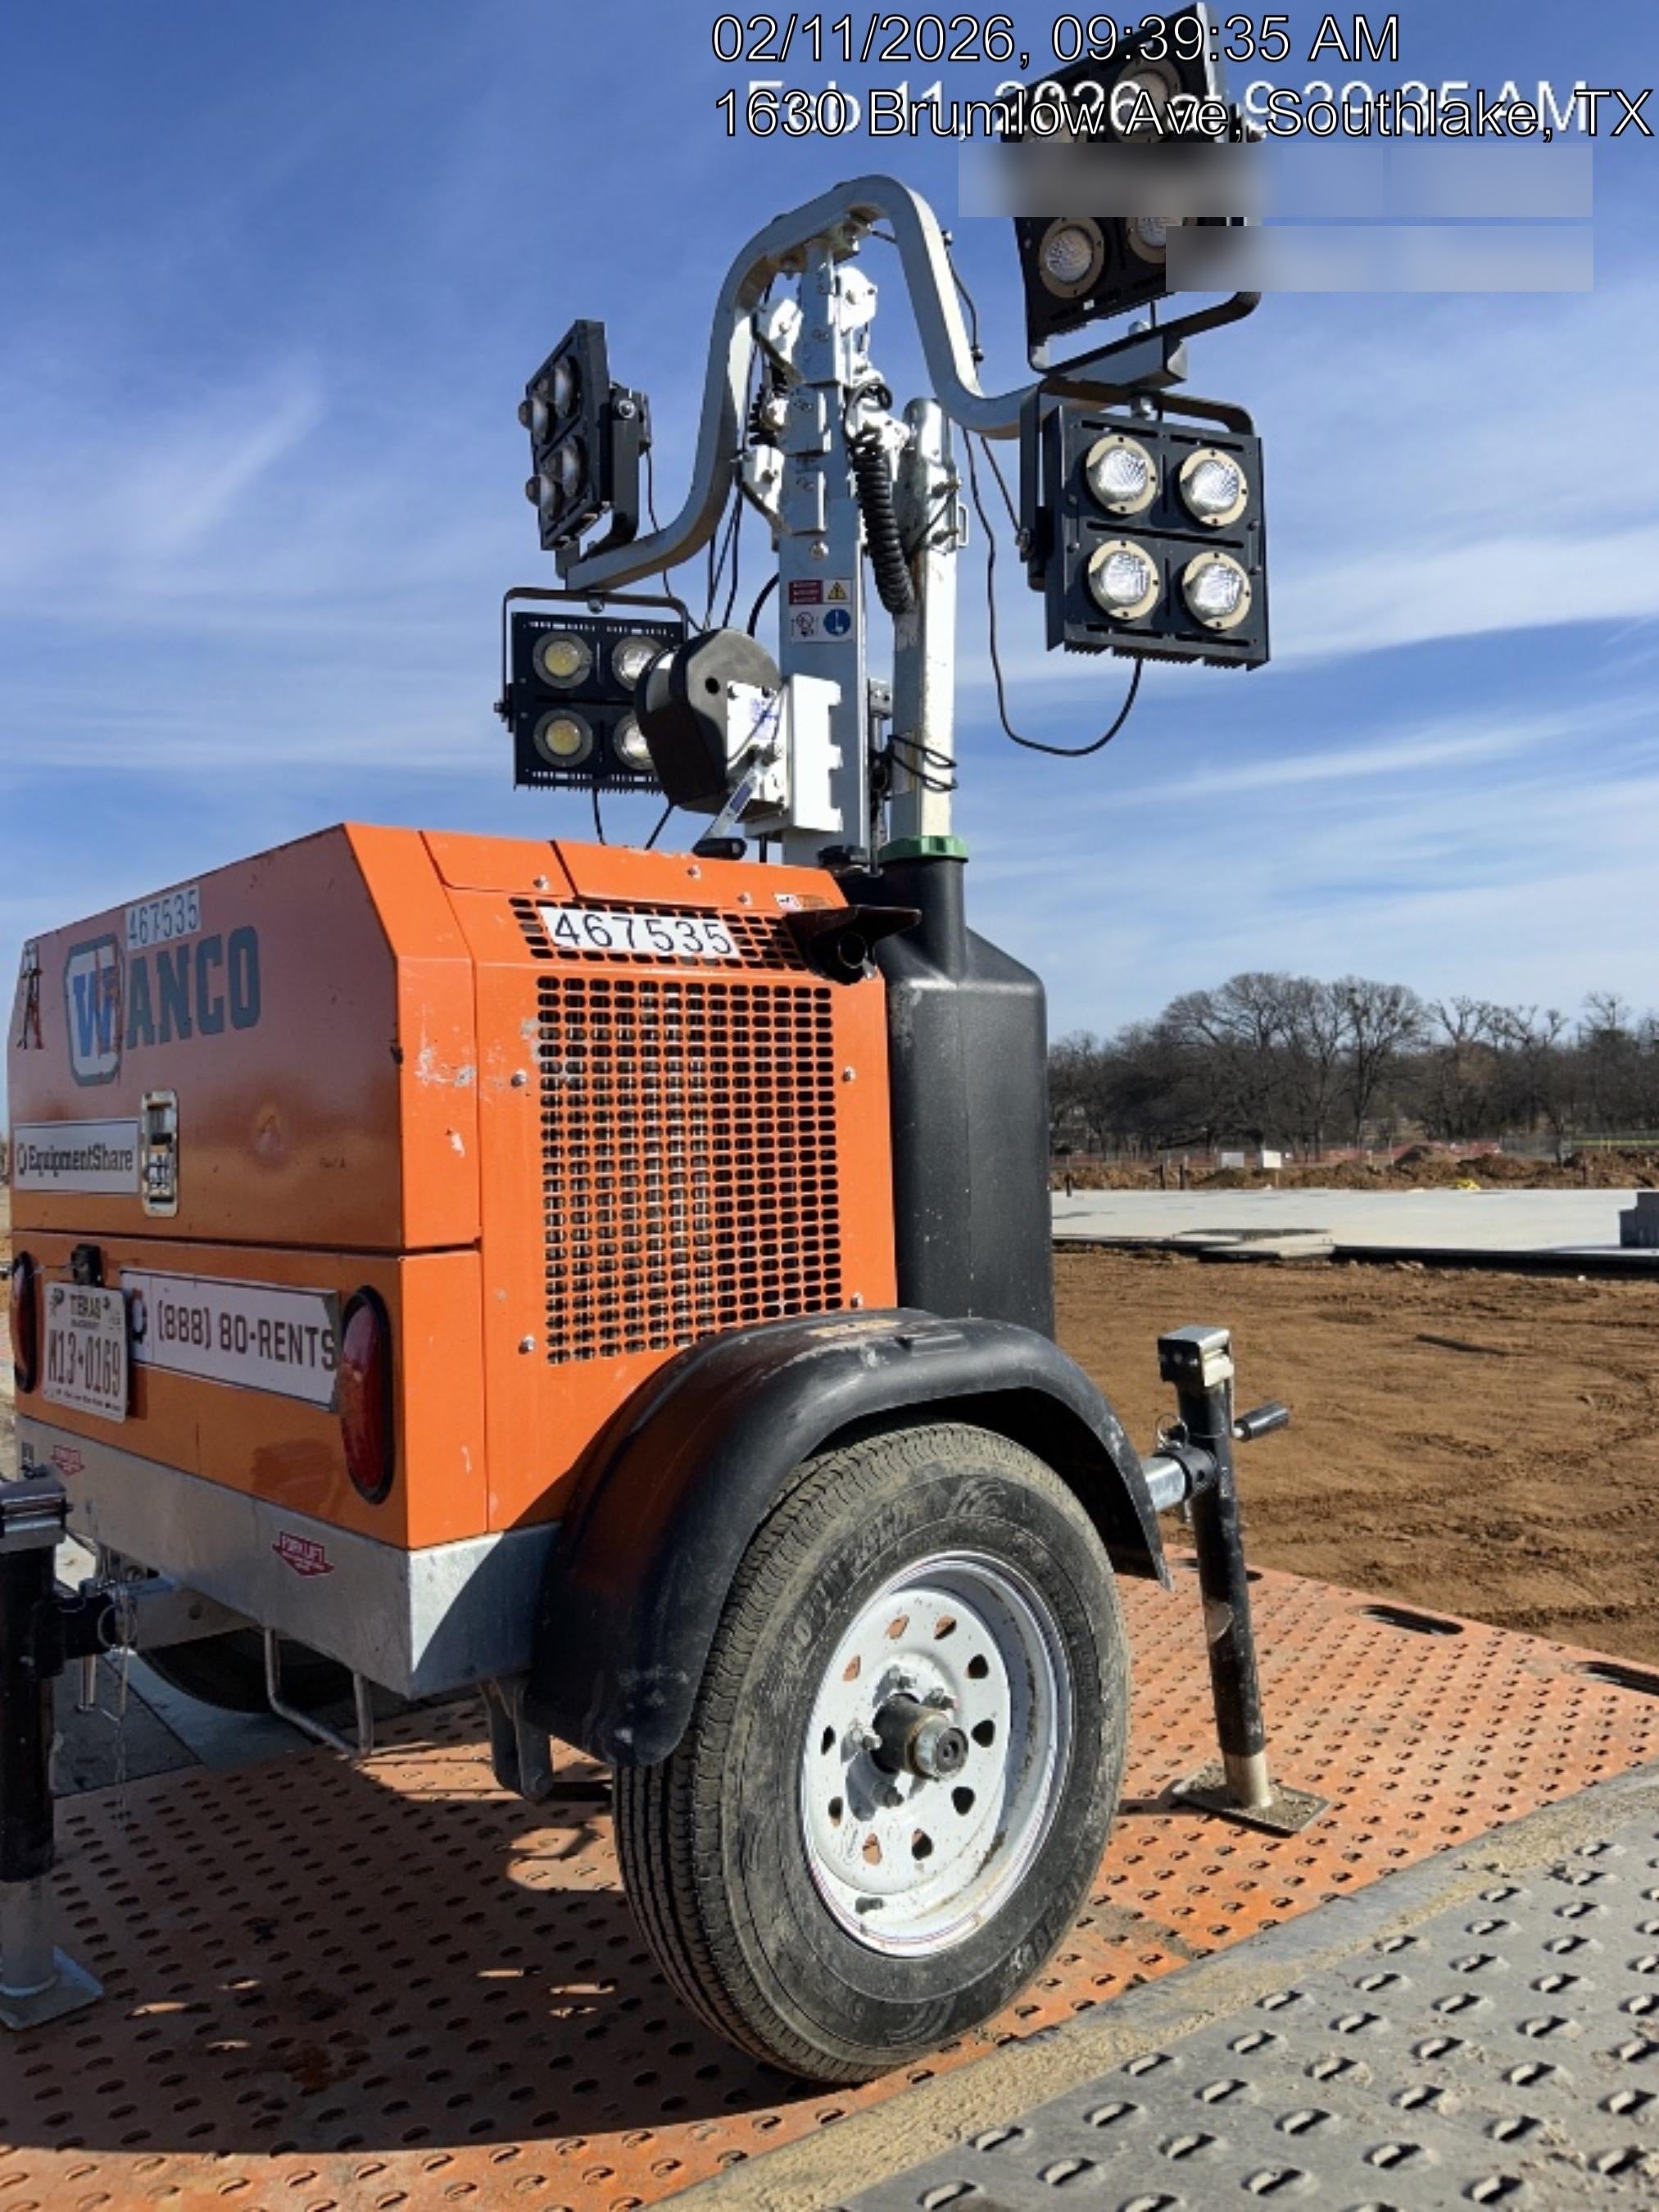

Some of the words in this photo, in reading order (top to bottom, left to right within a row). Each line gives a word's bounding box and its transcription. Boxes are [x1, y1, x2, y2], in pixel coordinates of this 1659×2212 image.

[127, 888, 198, 946] 467535
[554, 911, 732, 956] 467535
[72, 925, 261, 1059] WANCO
[28, 1142, 134, 1178] EquipmentShare
[158, 1300, 212, 1350] (888)
